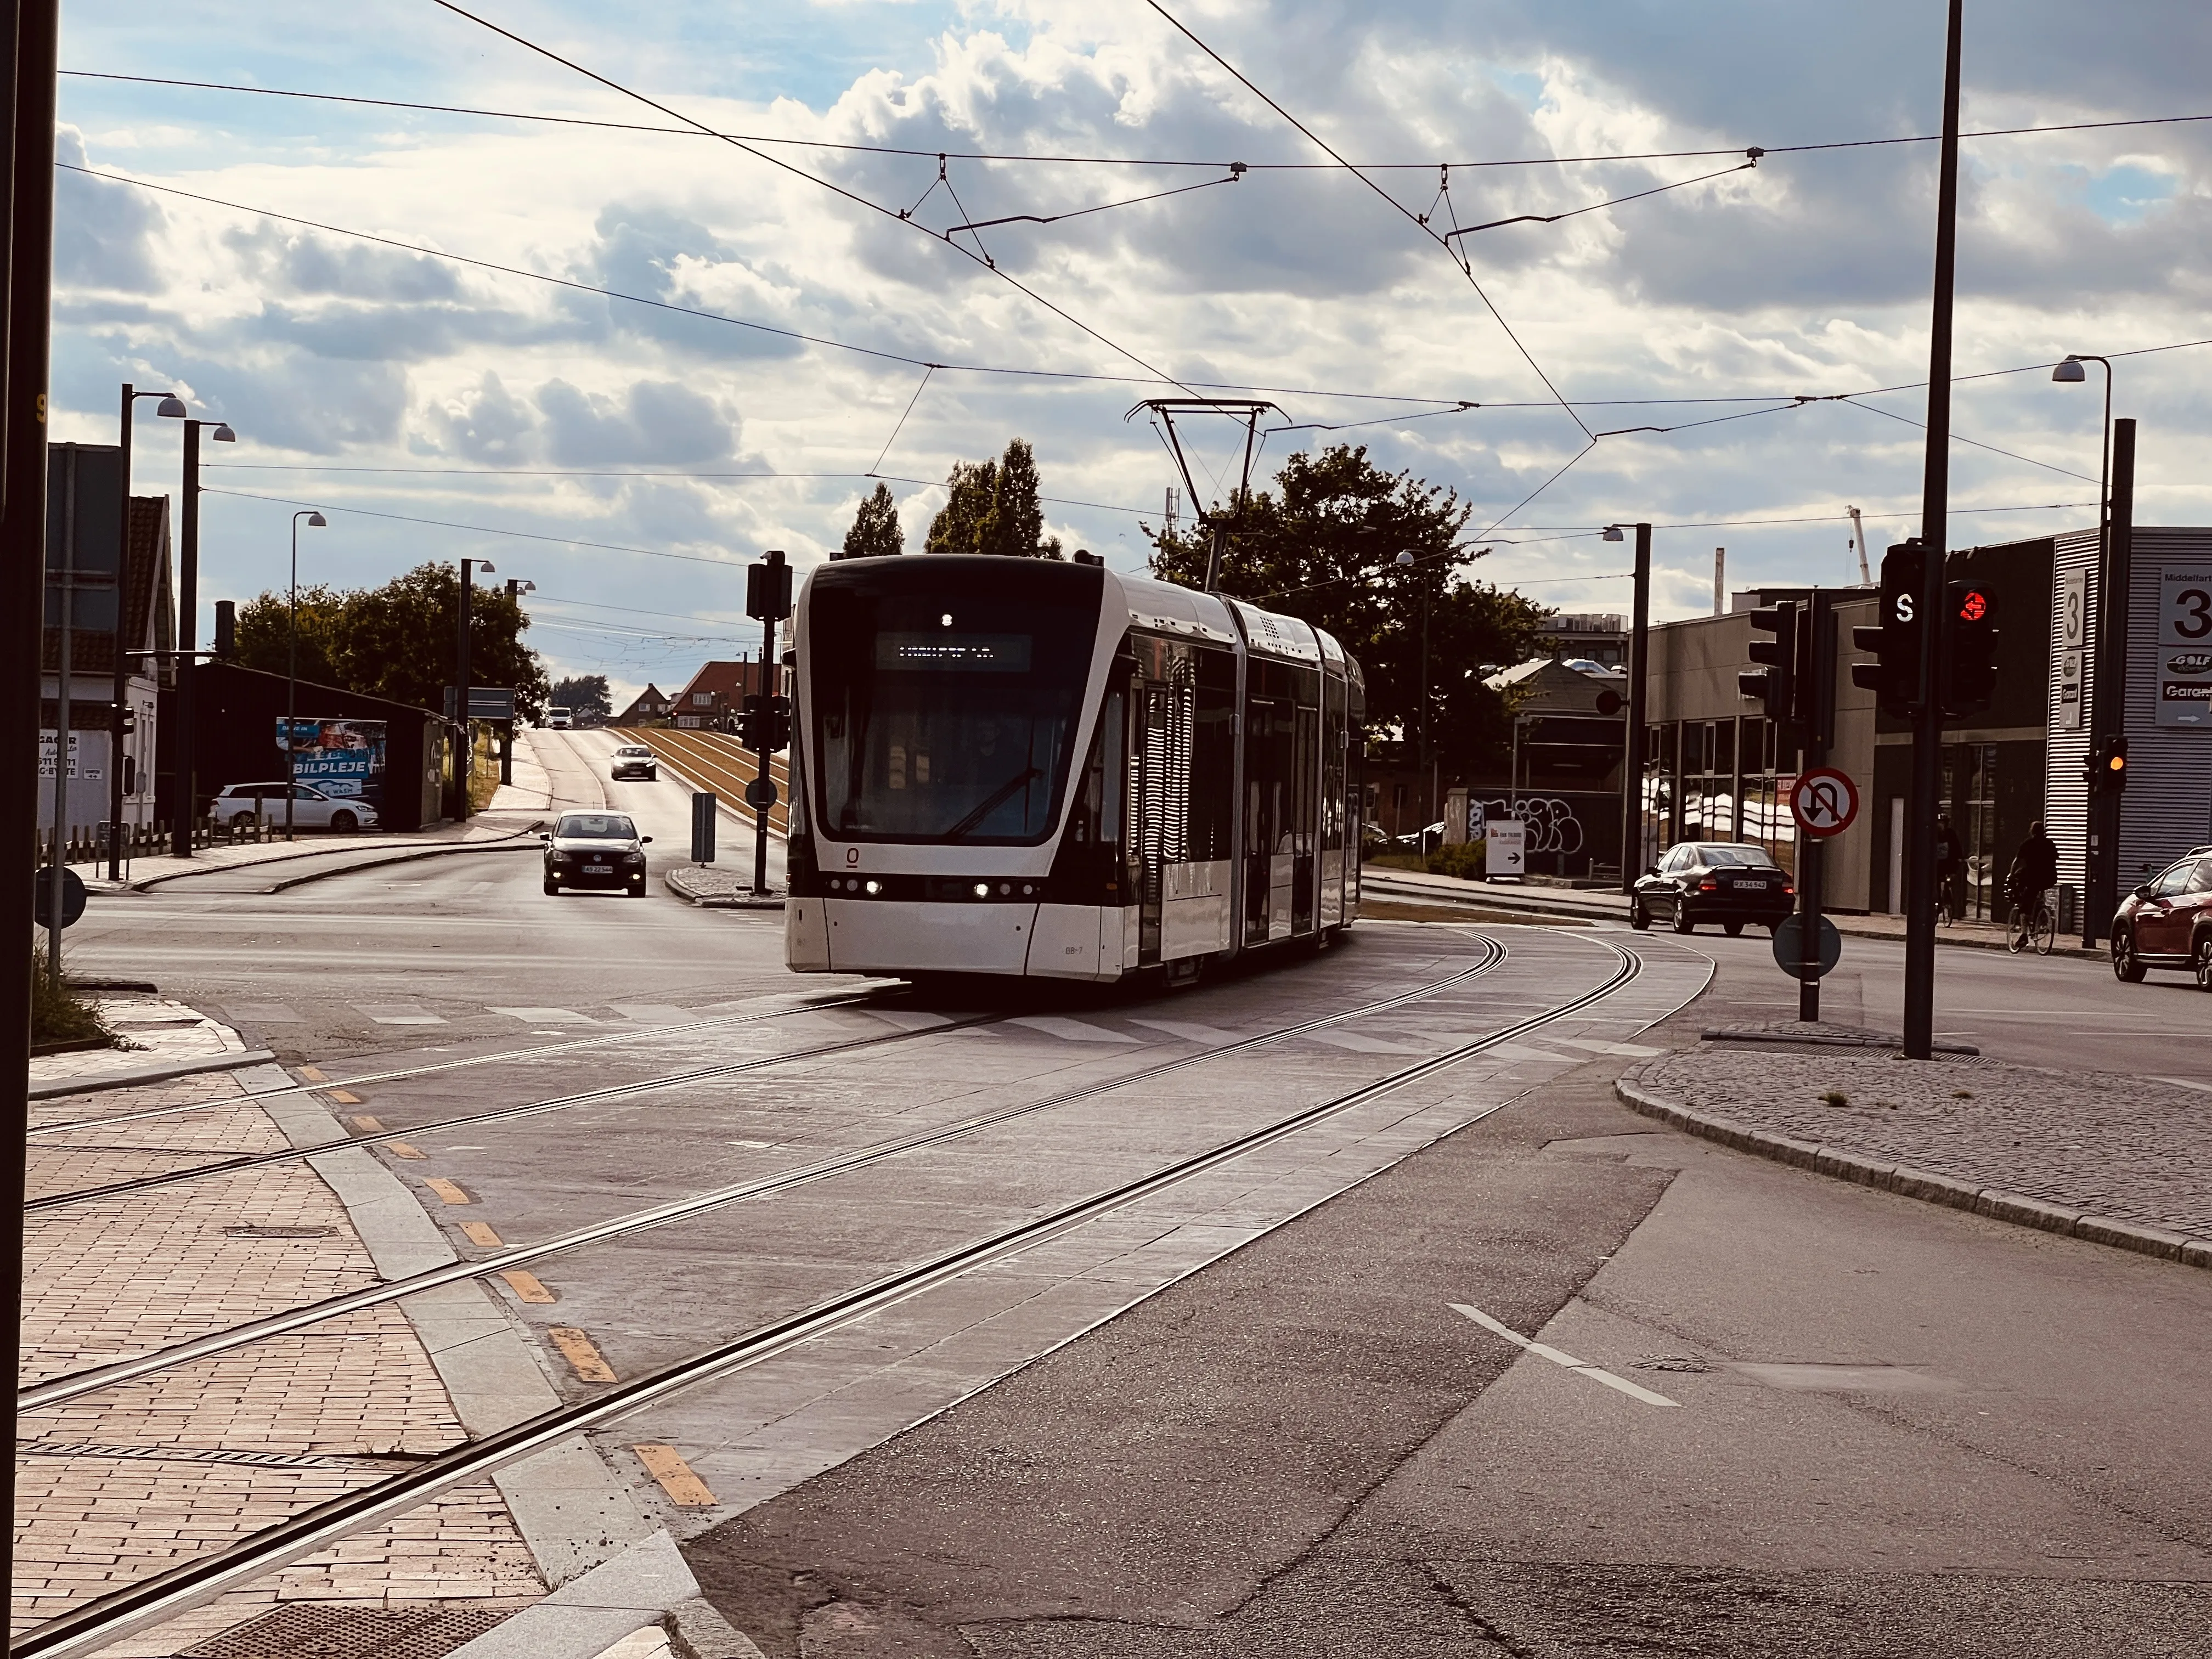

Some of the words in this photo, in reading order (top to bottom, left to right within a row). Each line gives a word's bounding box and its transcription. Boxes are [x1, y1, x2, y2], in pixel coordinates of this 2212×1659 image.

[2067, 592, 2078, 639] 3
[2174, 589, 2212, 638] 3
[2176, 656, 2211, 665] GOLF
[2166, 685, 2212, 697] Garan
[293, 761, 365, 774] BILPLEJE
